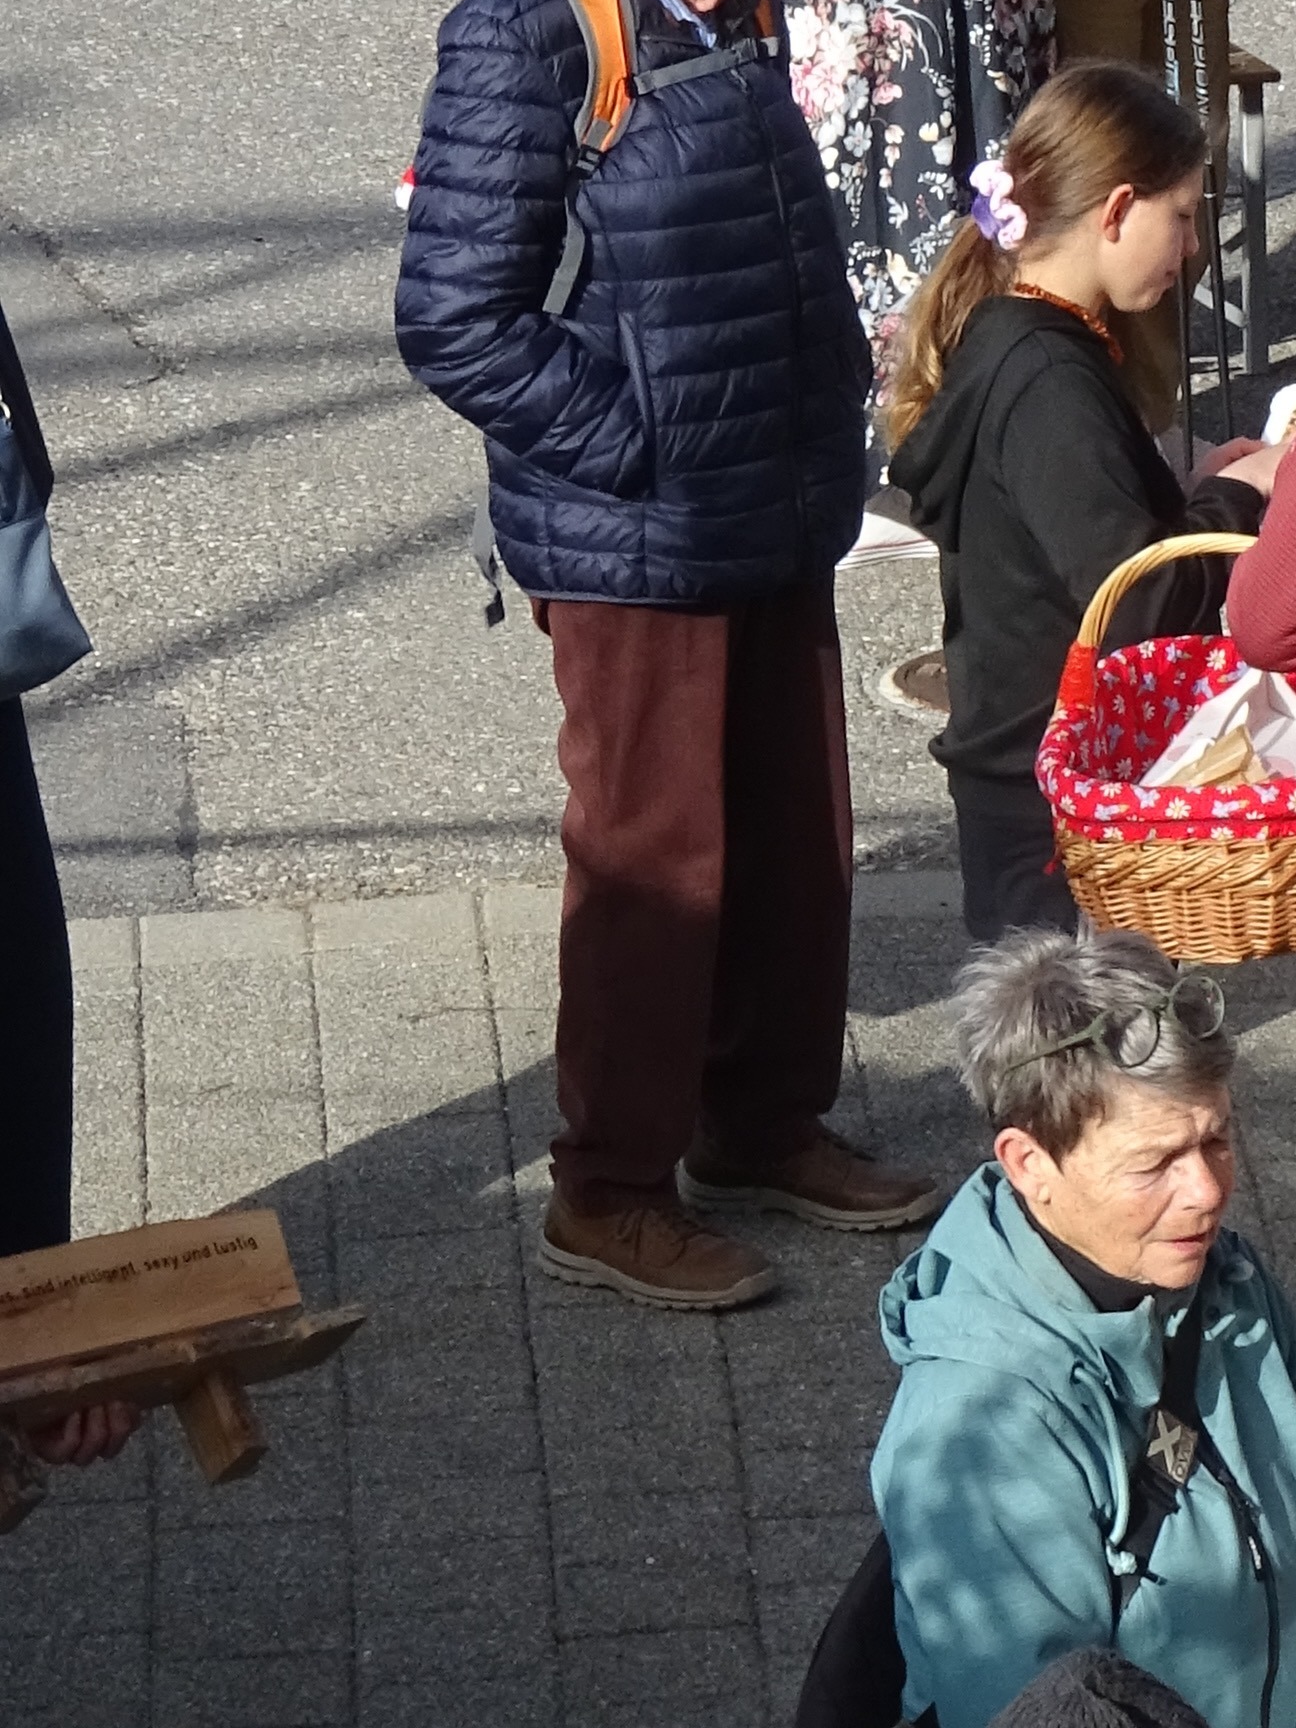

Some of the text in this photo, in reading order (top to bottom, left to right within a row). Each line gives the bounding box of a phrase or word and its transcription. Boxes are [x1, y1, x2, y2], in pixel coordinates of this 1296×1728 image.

[143, 1253, 178, 1273] sexy
[182, 1244, 212, 1265] und
[214, 1235, 259, 1256] lustig
